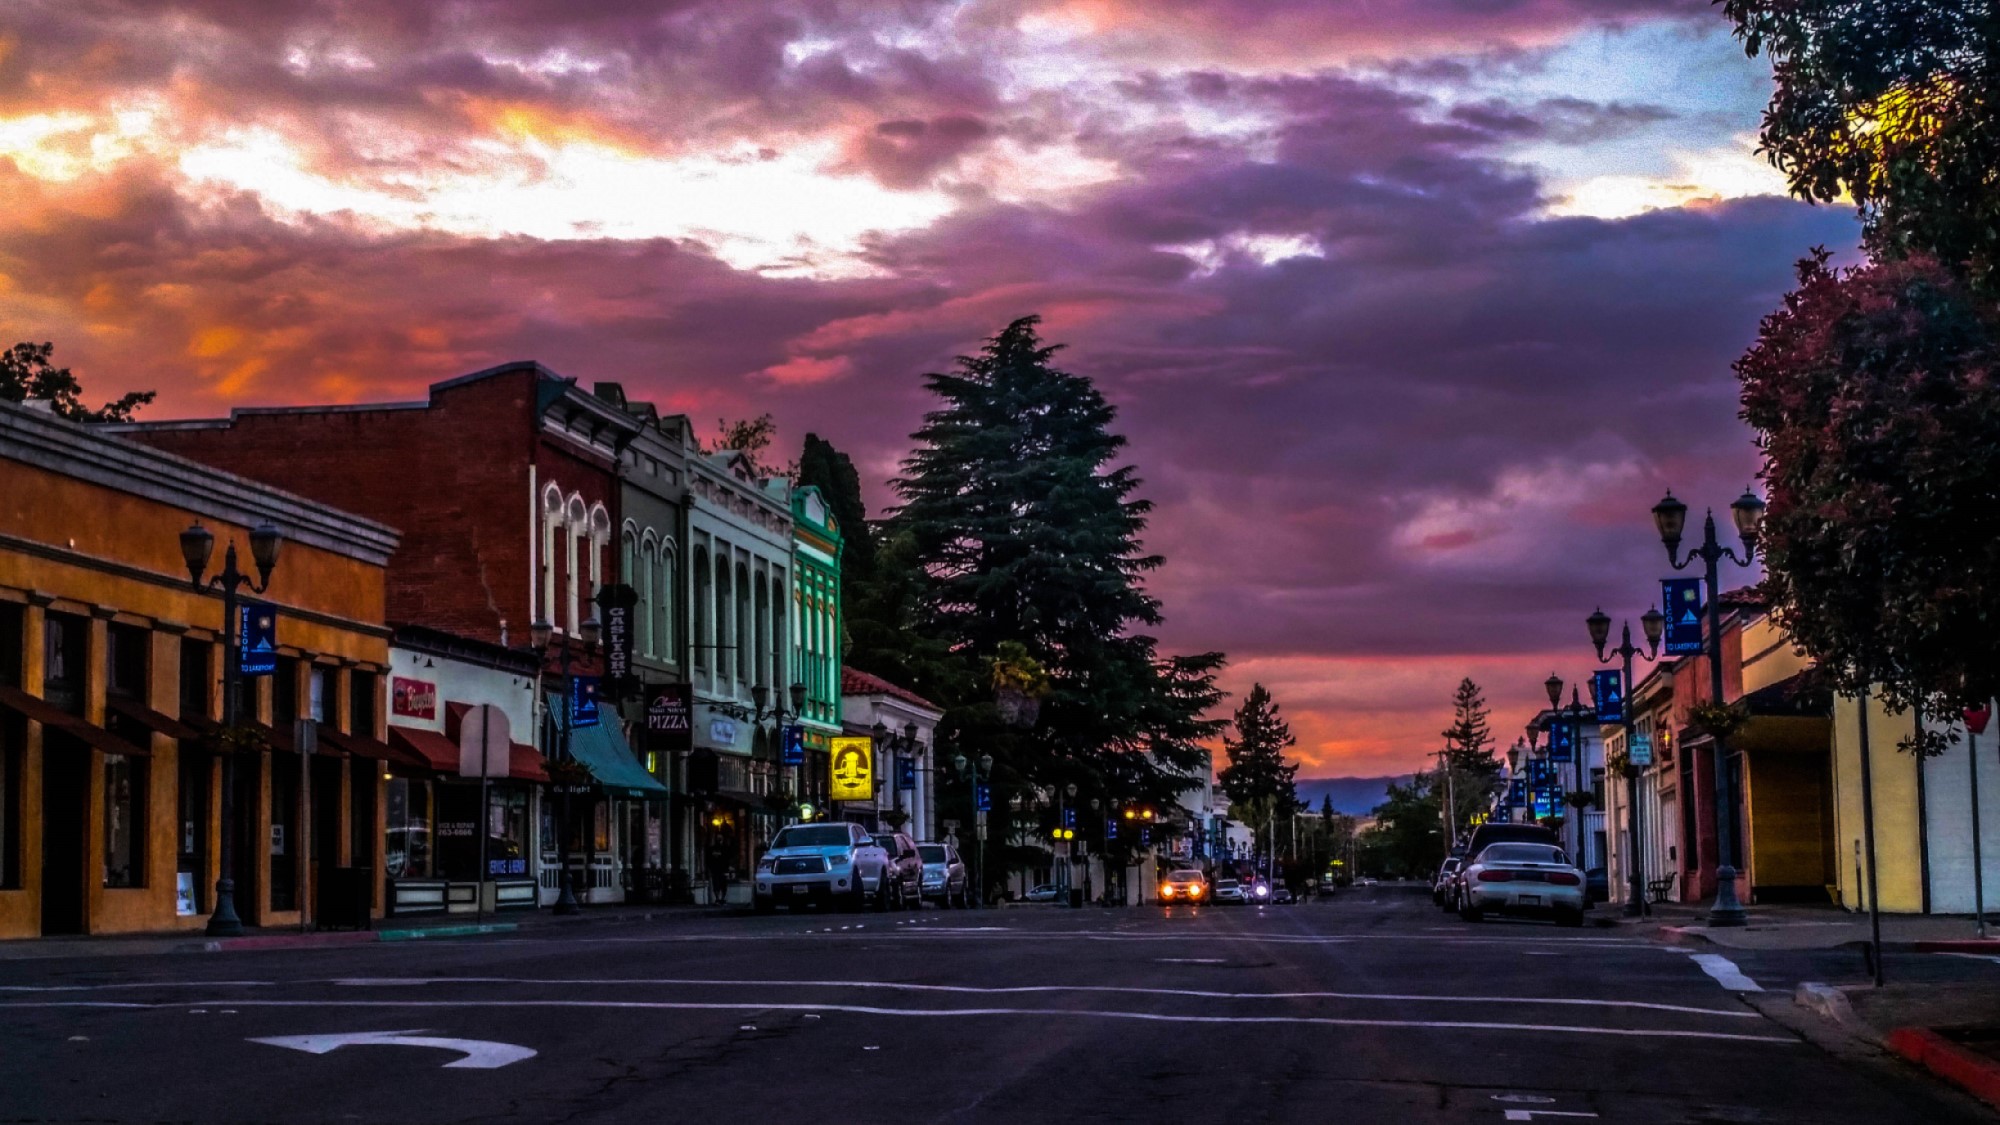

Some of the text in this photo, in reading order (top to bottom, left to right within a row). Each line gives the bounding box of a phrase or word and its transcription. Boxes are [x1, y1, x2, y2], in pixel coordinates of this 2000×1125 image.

[242, 607, 250, 661] WELCOME
[1664, 585, 1674, 639] WELCOME
[609, 607, 625, 679] GASLIGHT
[648, 715, 690, 729] PIZZA
[553, 783, 591, 795] Galight
